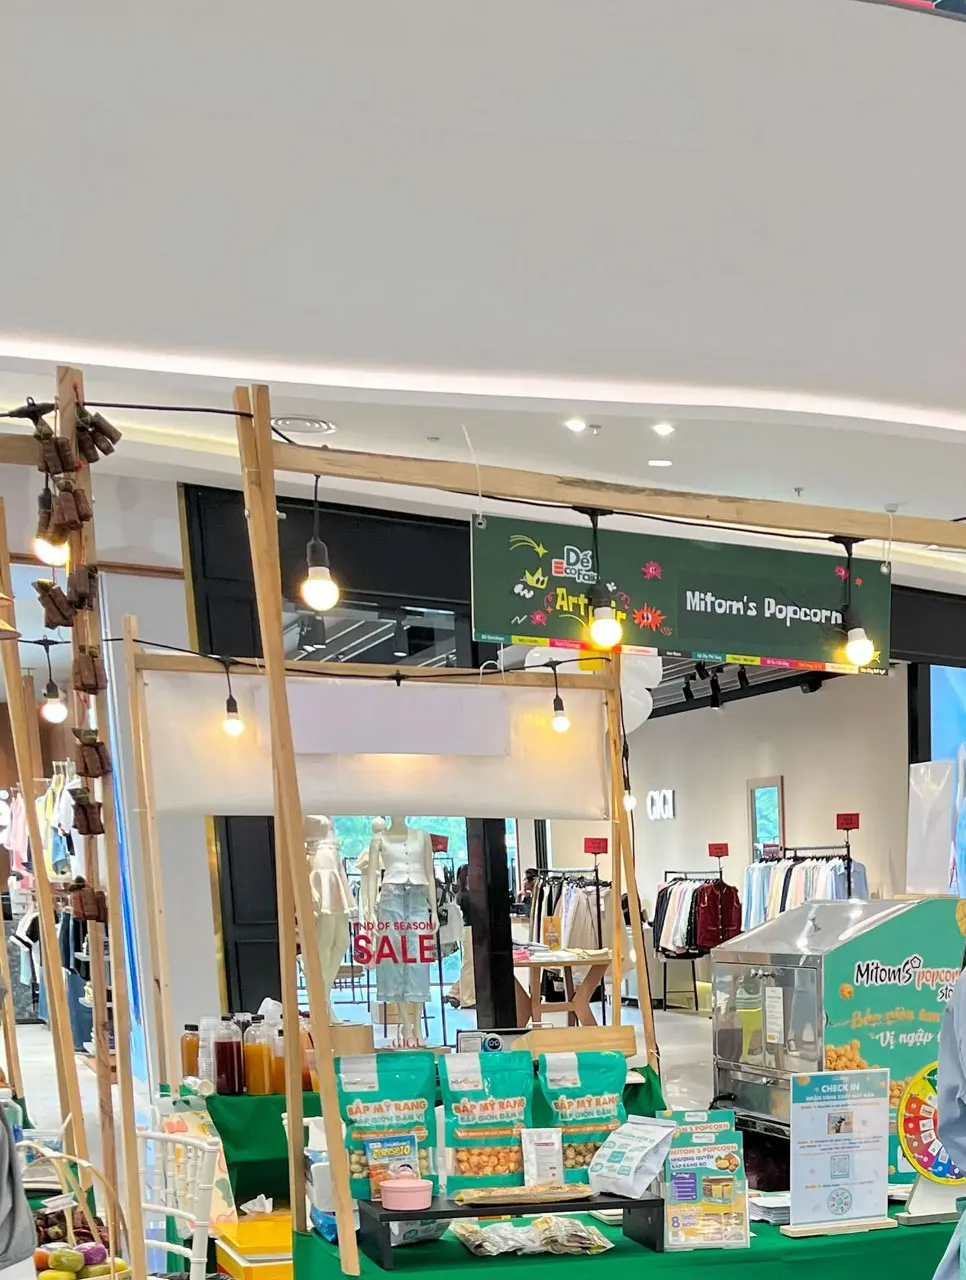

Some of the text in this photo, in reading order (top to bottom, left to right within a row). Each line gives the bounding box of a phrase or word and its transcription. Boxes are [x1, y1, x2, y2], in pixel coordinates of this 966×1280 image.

[555, 587, 588, 616] Art
[686, 591, 843, 627] Mitom's Popcorn
[377, 921, 390, 931] OF
[394, 921, 434, 931] SEASON
[353, 934, 435, 965] SALE
[916, 970, 962, 988] popcor
[939, 987, 954, 1000] sto
[875, 1028, 933, 1049] Vị ngập
[821, 1084, 848, 1093] CHECK
[394, 1100, 426, 1112] RANG
[499, 1098, 525, 1110] RANG
[596, 1095, 618, 1107] RAN
[695, 1123, 728, 1131] POPCORN
[702, 1145, 736, 1153] POPCORN
[672, 1216, 680, 1228] 8
